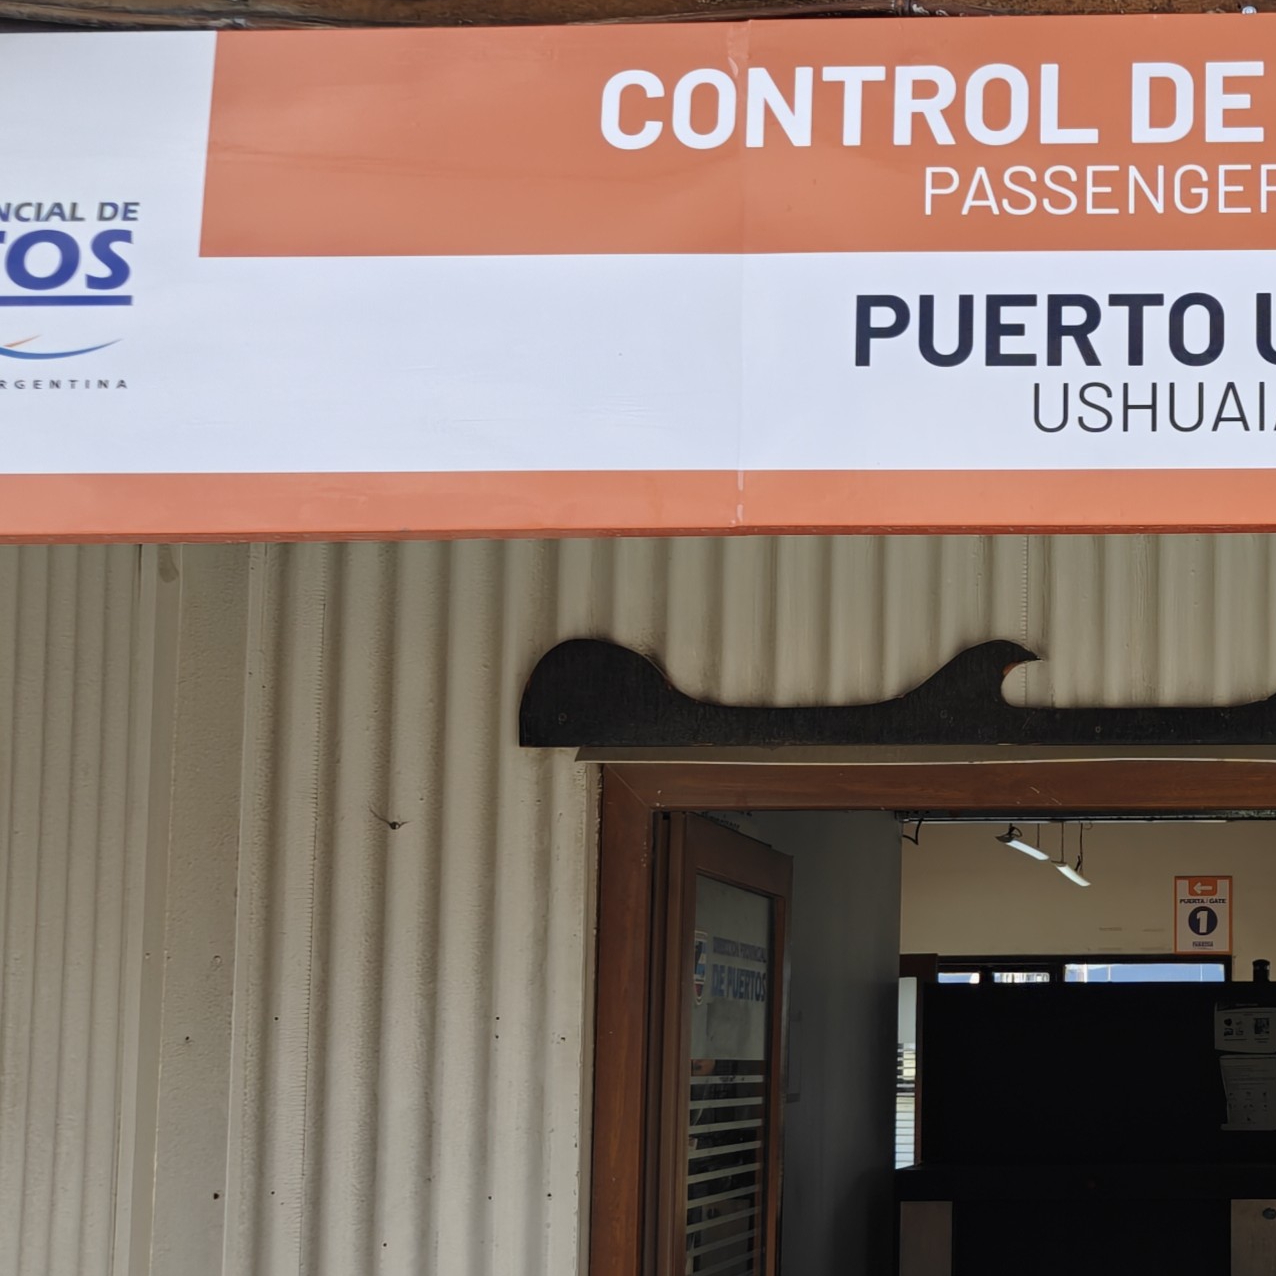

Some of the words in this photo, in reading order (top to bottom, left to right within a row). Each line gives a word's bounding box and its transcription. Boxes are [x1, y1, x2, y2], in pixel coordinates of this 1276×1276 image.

[600, 63, 1099, 151] CONTROL
[1131, 60, 1265, 144] DE
[97, 202, 140, 222] DE
[854, 292, 1226, 368] PUERTO
[1196, 910, 1209, 933] 1
[726, 965, 767, 1003] PUERTOS
